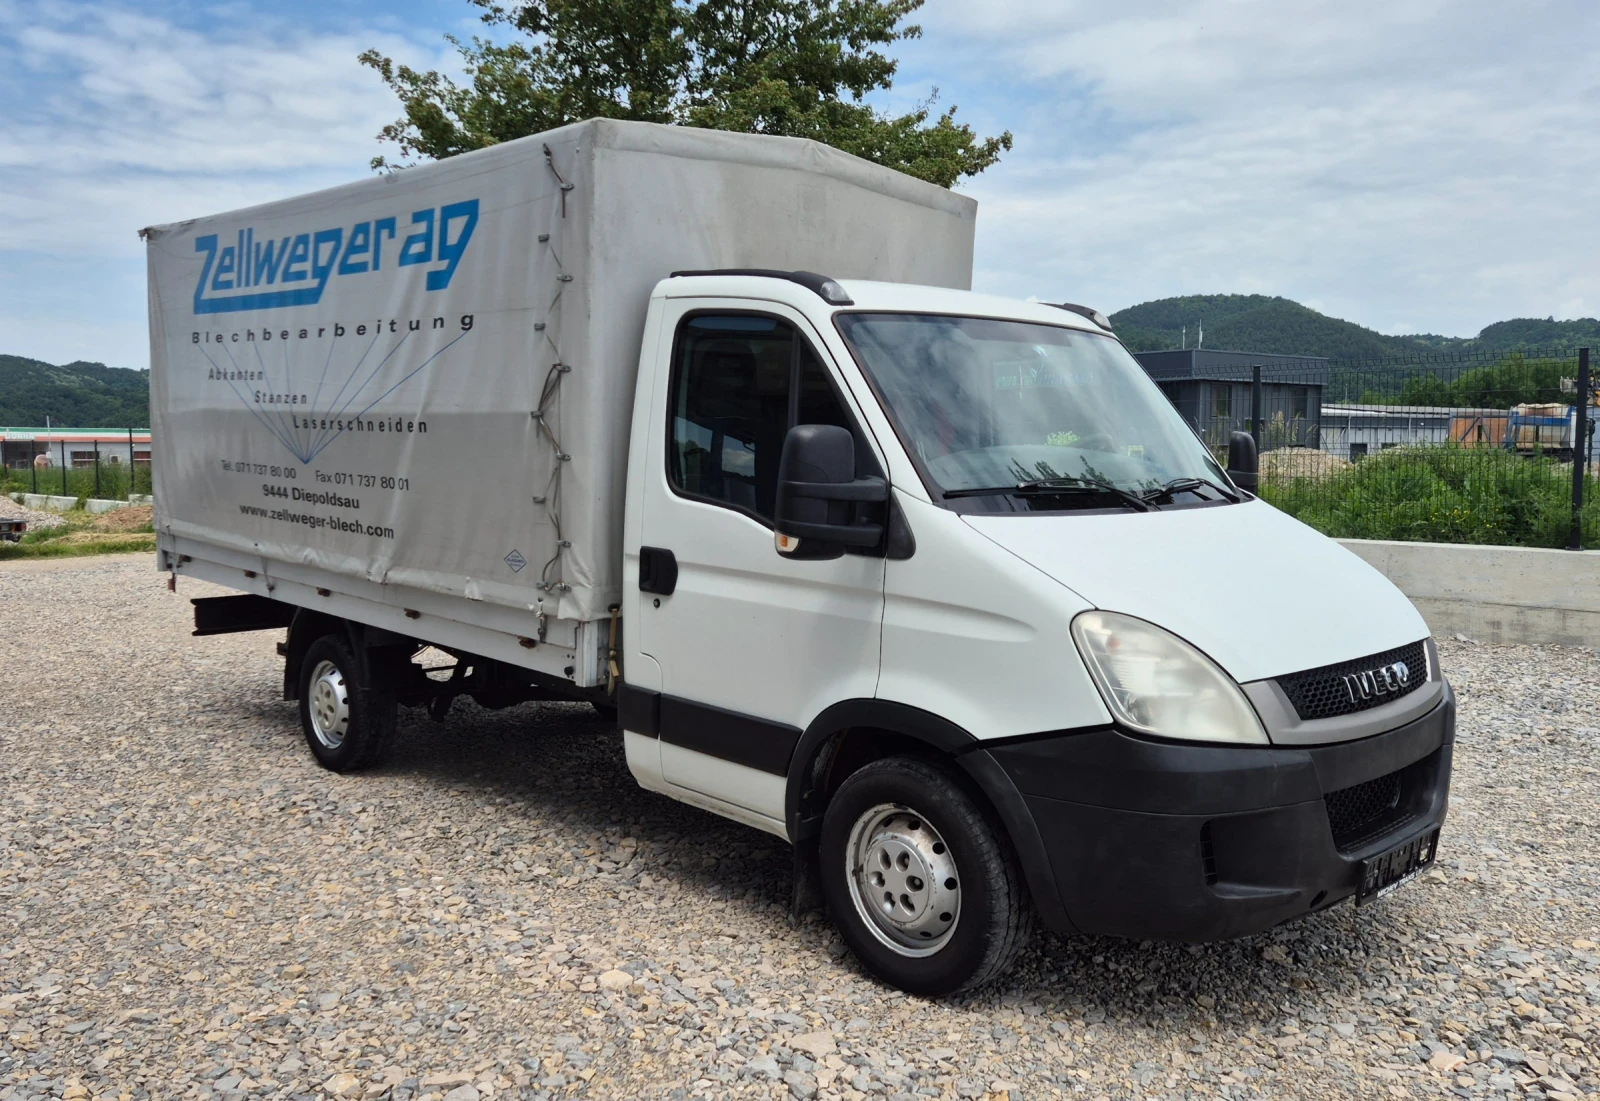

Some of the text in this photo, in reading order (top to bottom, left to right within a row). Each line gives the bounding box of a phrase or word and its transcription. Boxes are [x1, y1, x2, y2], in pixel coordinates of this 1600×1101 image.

[193, 199, 479, 315] Zellweger ag
[192, 313, 475, 344] Blechbearbeitung
[208, 368, 264, 381] Abkanten
[254, 391, 307, 405] Stanzen
[293, 415, 427, 434] Laserschneiden
[221, 460, 297, 479] Tel. 071 737 80 00
[315, 470, 410, 491] Fax 071 737 80 01
[262, 484, 361, 509] 9444 Diepoldsau
[239, 504, 395, 539] www.zellweger-blech.com
[1342, 661, 1411, 703] IVECO
